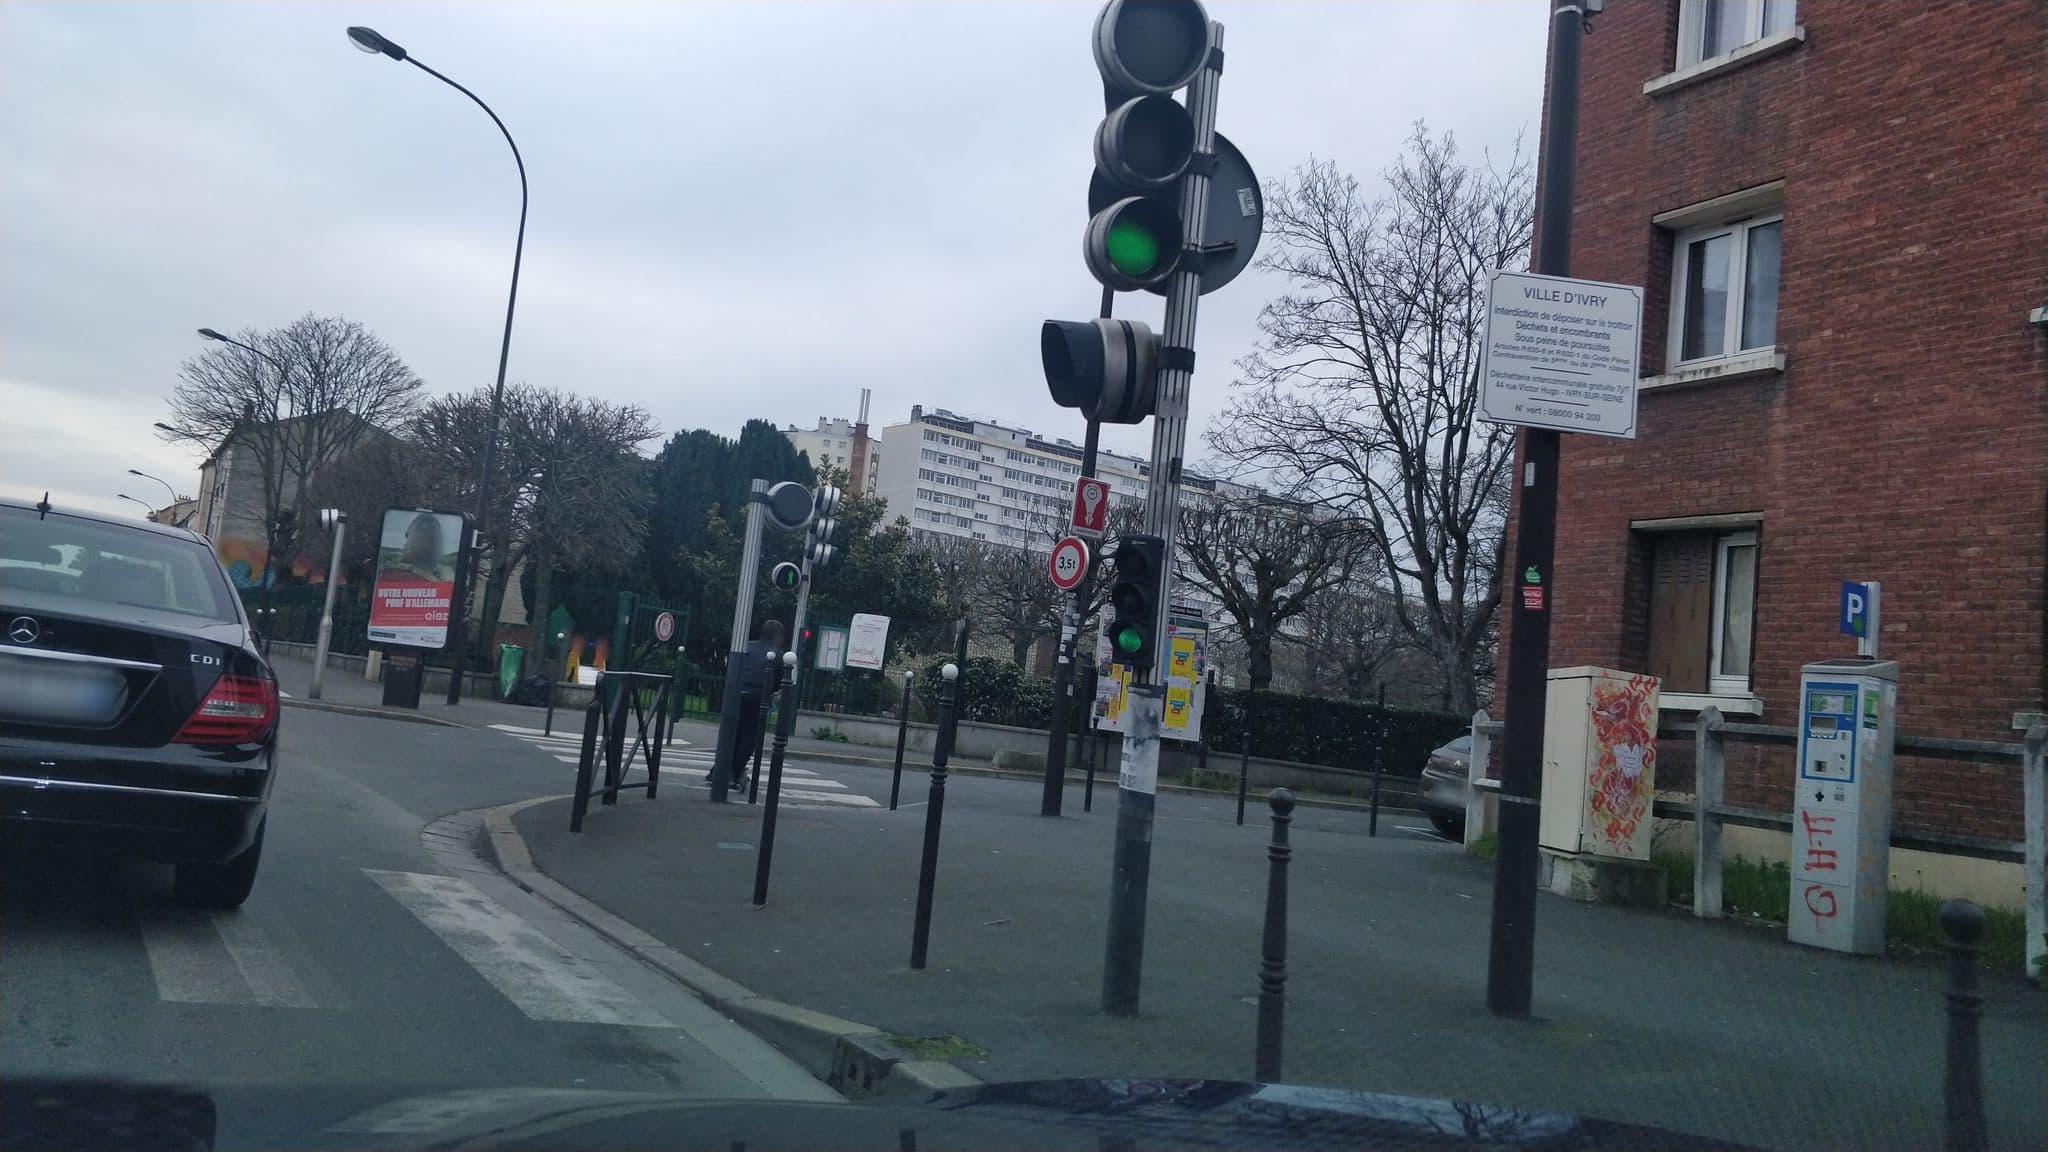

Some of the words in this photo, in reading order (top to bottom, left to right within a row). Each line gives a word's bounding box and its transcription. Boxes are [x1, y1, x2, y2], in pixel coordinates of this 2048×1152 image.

[1524, 287, 1560, 302] VILLE
[1564, 293, 1608, 307] D'IVRY
[1495, 306, 1538, 319] Interdiction
[1541, 311, 1550, 320] de
[1552, 313, 1583, 324] déposer
[1585, 318, 1597, 326] sur
[1599, 318, 1606, 327] le
[1608, 320, 1634, 330] trottoir
[1516, 321, 1548, 332] Déchets
[1560, 327, 1610, 340] encombrants
[1494, 343, 1519, 351] Articles
[1515, 333, 1534, 343] Sous
[1536, 337, 1557, 346] peine
[1559, 339, 1568, 347] de
[1571, 341, 1610, 352] poursuites
[1493, 351, 1539, 361] Contravention
[1609, 365, 1630, 373] classe
[1532, 376, 1587, 387] intercommunale
[1589, 382, 1615, 392] gratuite
[1519, 384, 1539, 392] Victor
[1566, 389, 1623, 403] IVRY-SUR-SEINE
[1587, 413, 1601, 421] 200
[1058, 556, 1076, 571] 3,5t
[378, 588, 401, 597] VOTRE
[402, 588, 437, 598] NOUVEAU
[385, 598, 404, 607] PROF
[405, 598, 450, 607] D'ALLEMAND
[1847, 592, 1864, 623] P
[190, 654, 220, 666] CDI
